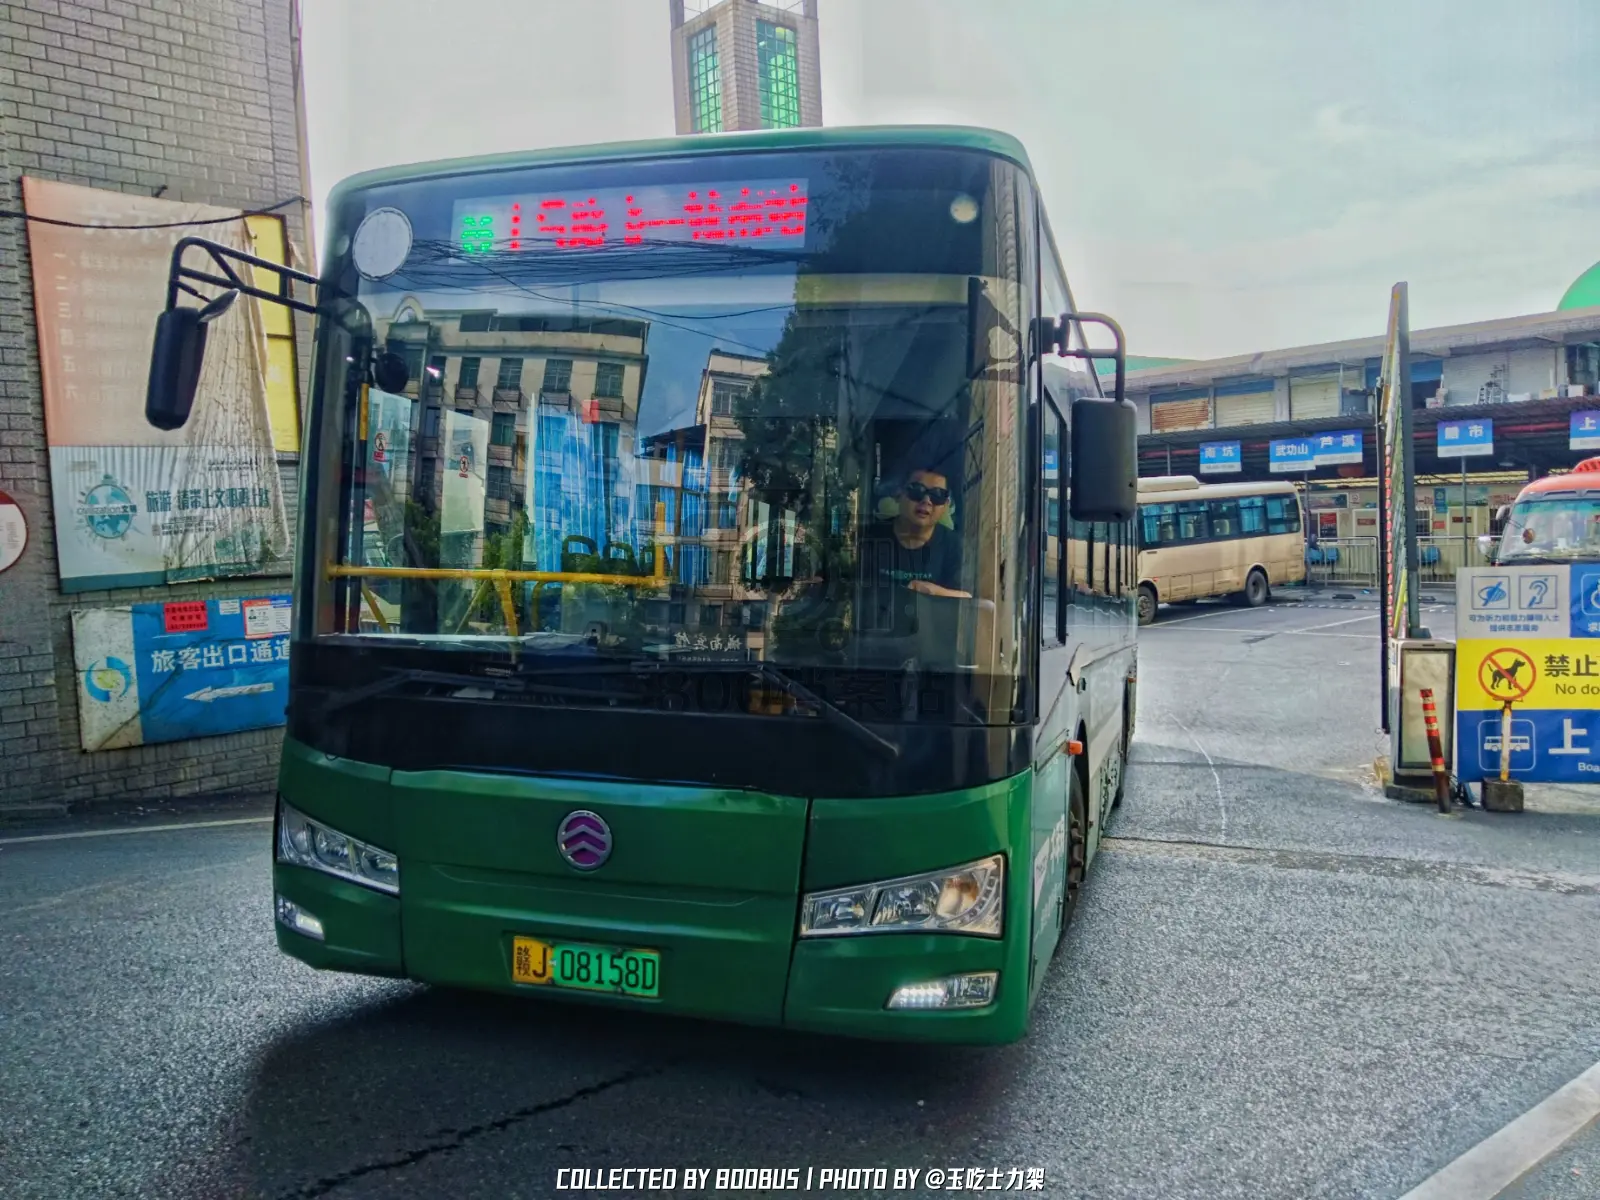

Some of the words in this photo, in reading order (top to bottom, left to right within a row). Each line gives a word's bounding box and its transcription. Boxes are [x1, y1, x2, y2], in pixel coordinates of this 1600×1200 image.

[1275, 443, 1309, 457] 武功山
[1555, 683, 1577, 696] No
[1548, 718, 1590, 756] 上
[560, 949, 657, 991] 08158D
